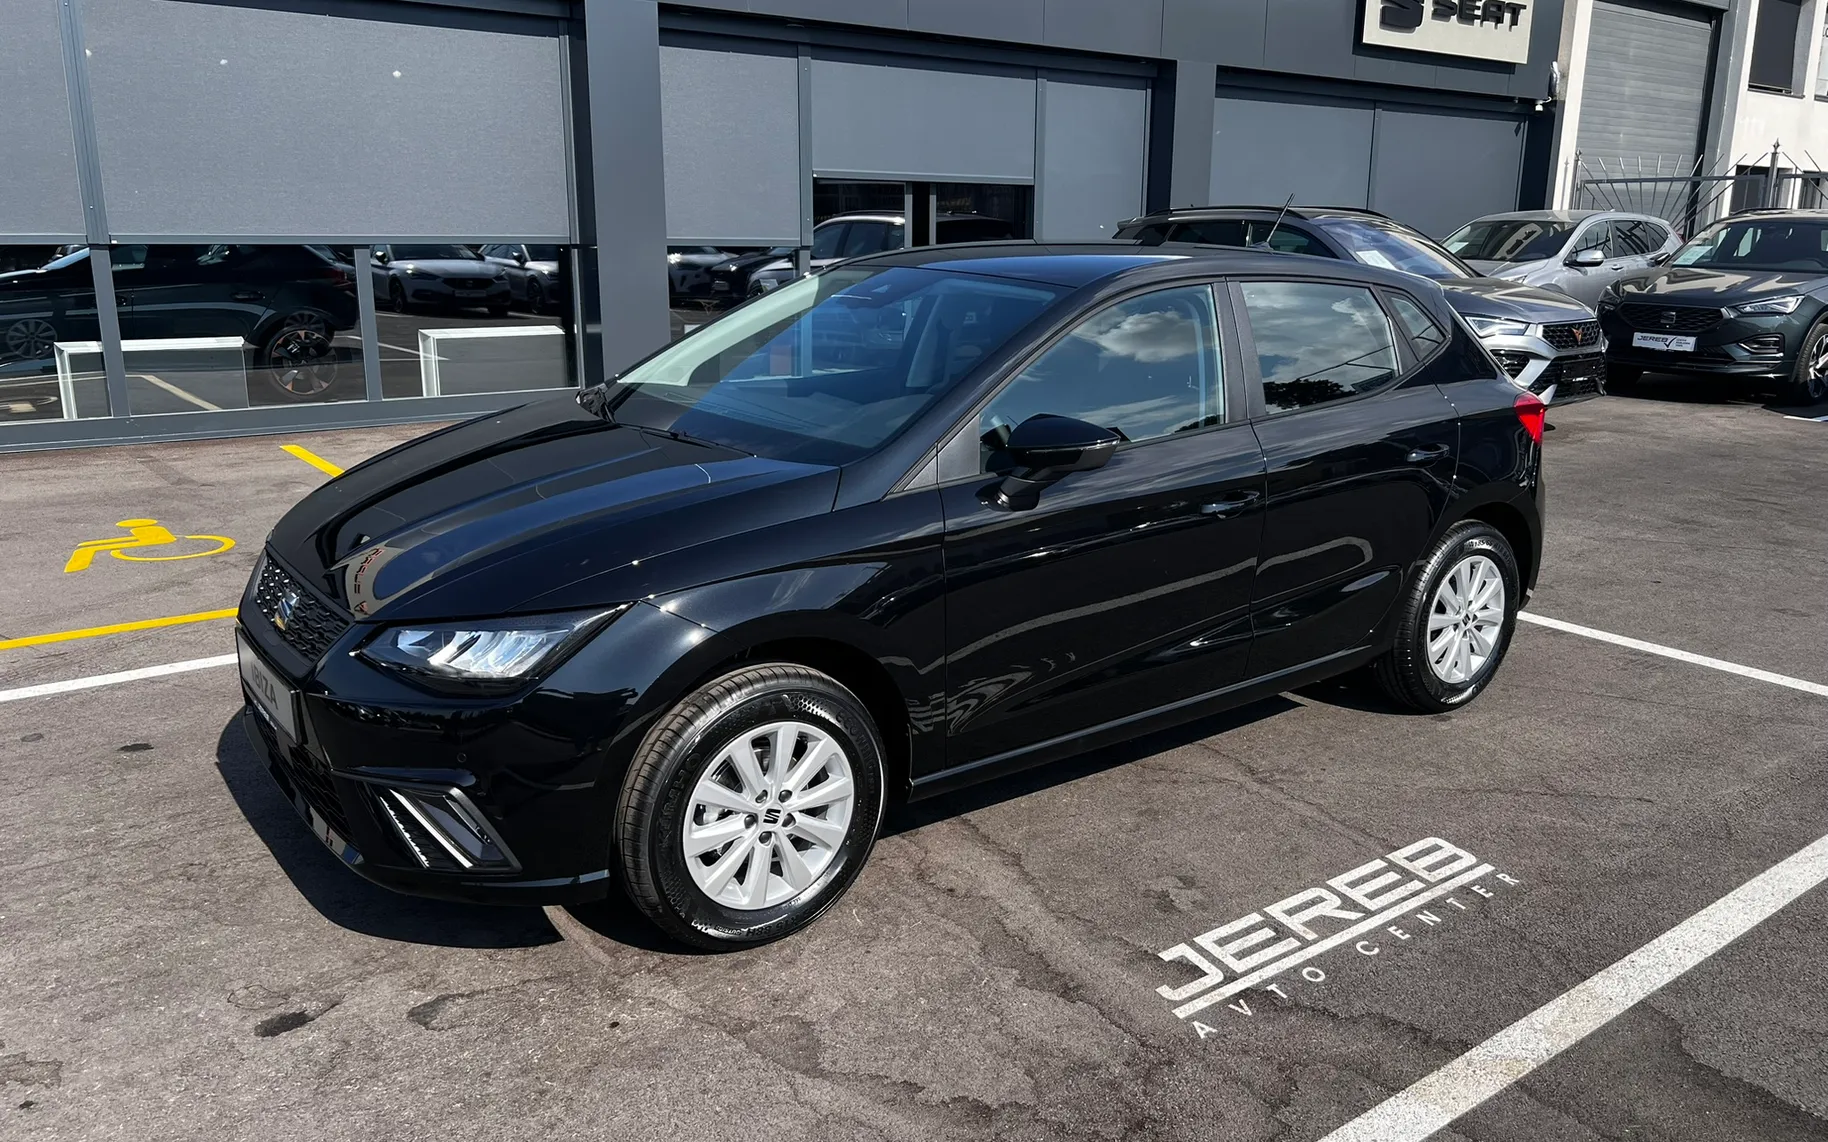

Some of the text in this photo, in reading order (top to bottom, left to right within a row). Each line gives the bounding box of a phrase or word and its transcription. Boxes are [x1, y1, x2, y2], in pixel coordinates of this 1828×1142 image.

[1432, 0, 1527, 29] SEAT
[1637, 335, 1669, 343] JEREB
[251, 662, 279, 711] IBIZA
[1154, 836, 1479, 1002] JEREB
[1190, 871, 1521, 1040] AVTO CENTER
